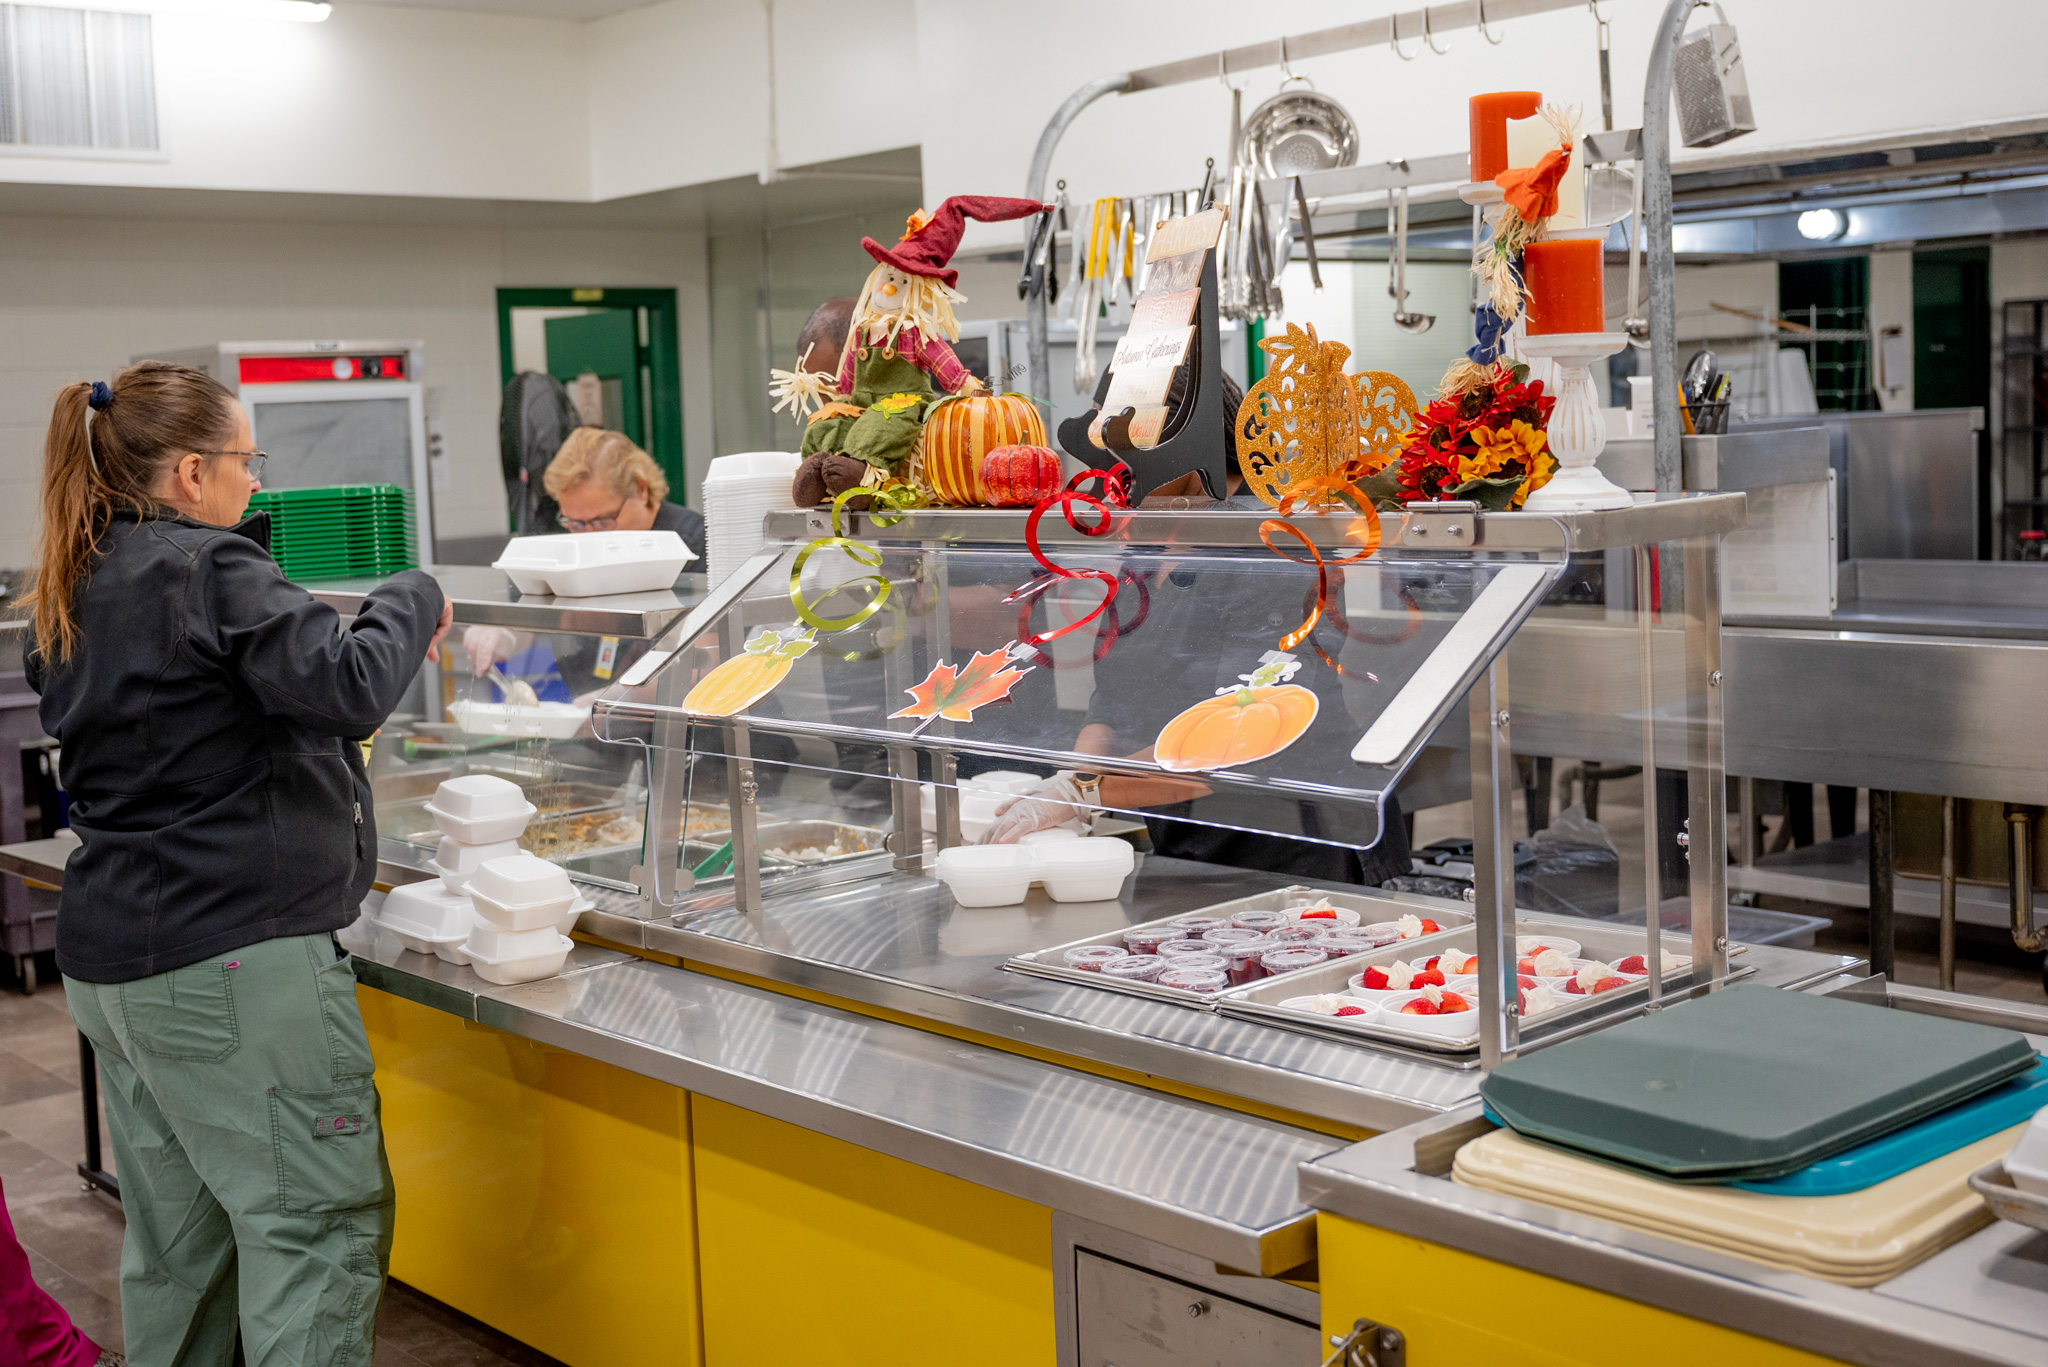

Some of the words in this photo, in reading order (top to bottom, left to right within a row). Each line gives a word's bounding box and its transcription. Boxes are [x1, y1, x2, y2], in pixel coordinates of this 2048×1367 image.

[1152, 212, 1220, 256] HARVEST
[1113, 343, 1144, 367] Autumn
[1145, 335, 1183, 368] Gatherings
